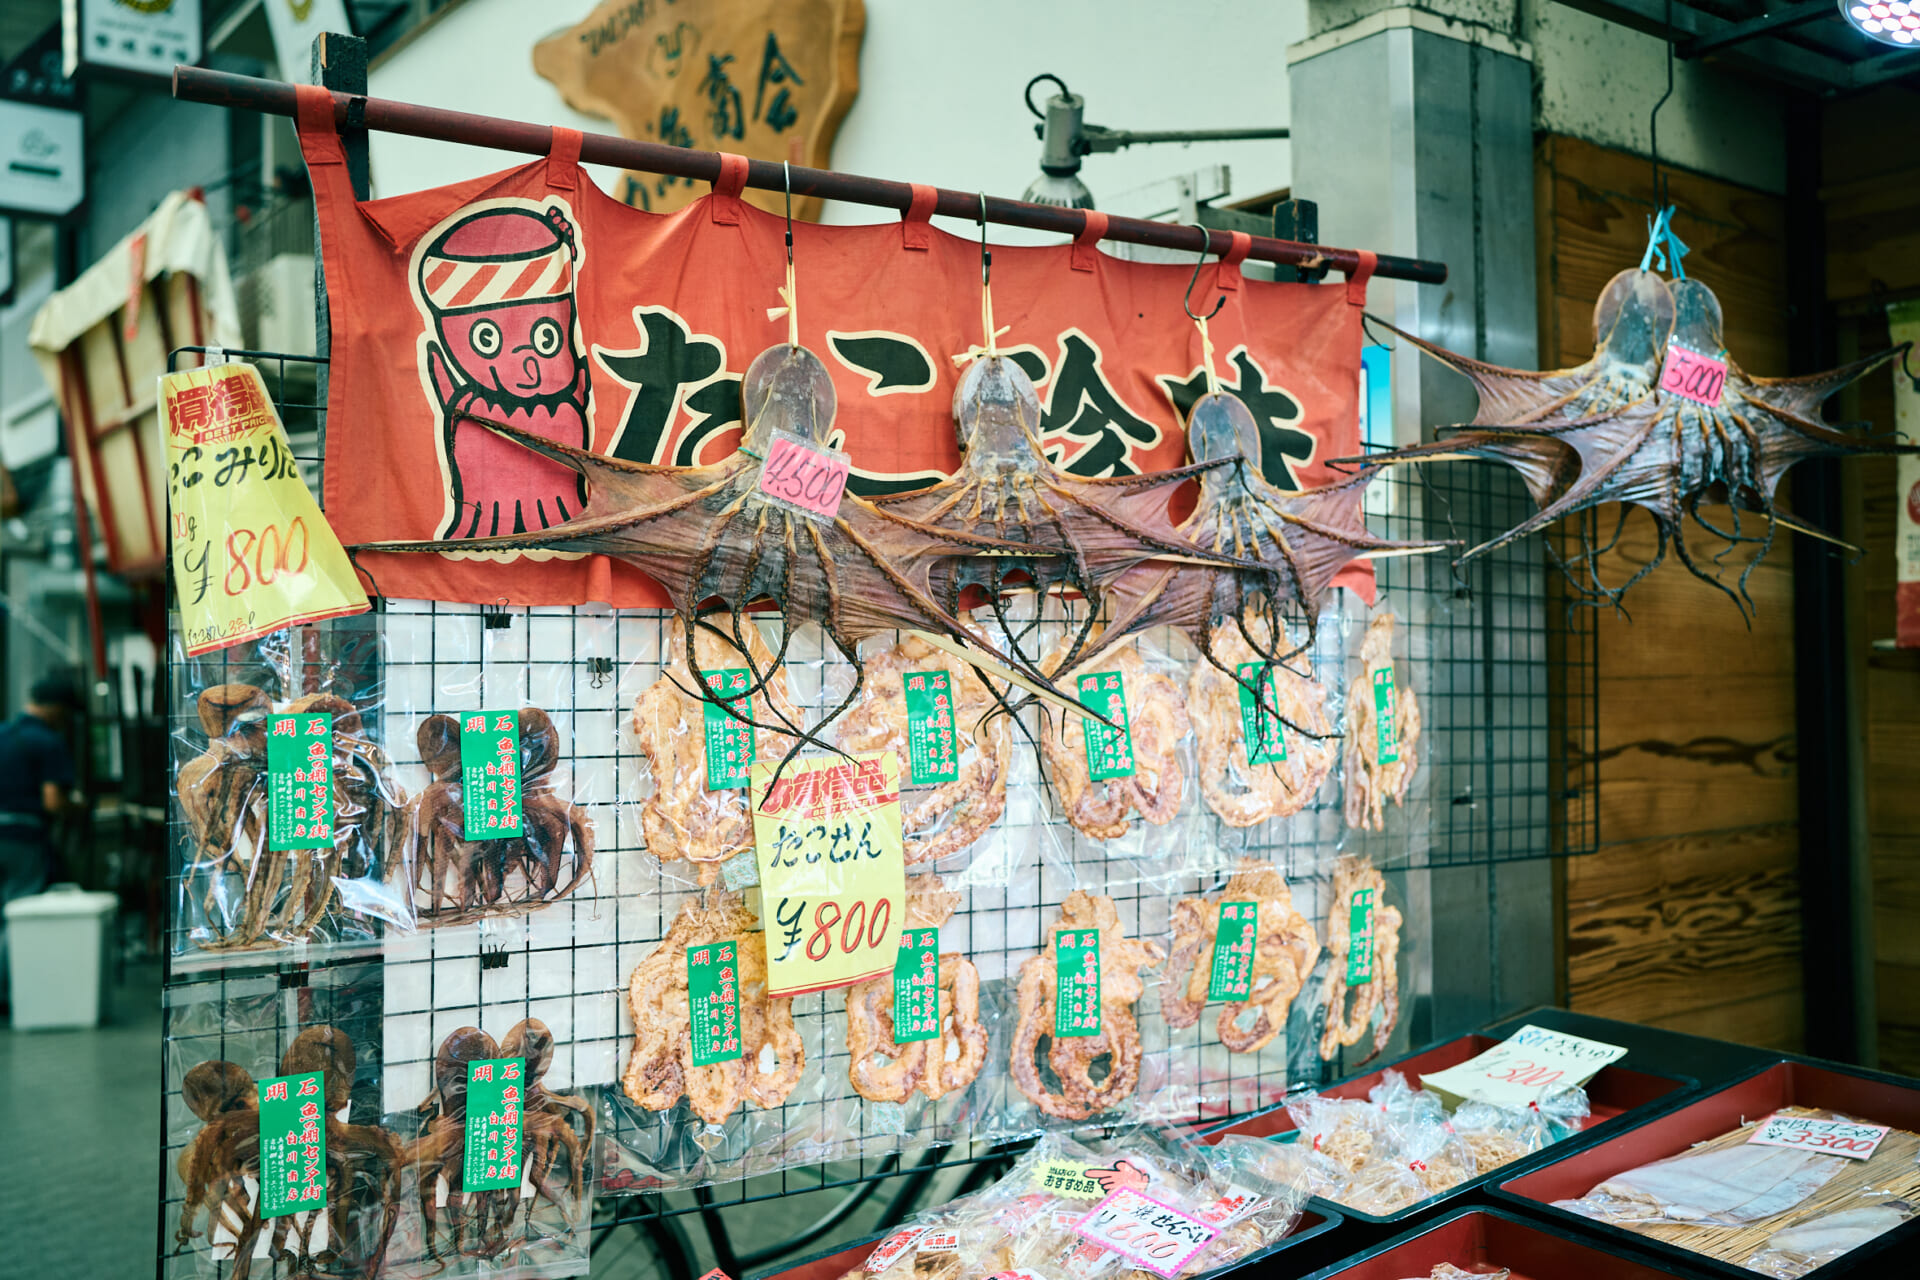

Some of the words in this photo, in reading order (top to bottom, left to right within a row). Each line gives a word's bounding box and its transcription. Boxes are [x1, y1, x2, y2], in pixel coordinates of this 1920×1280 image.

[272, 718, 328, 737] 明石
[464, 715, 514, 733] 明石
[771, 822, 882, 868] たこせん
[774, 897, 891, 962] ¥800
[692, 946, 733, 966] 明石
[471, 1063, 520, 1082] 明石
[264, 1078, 319, 1102] 明石
[1044, 1175, 1095, 1193] おすすめ品
